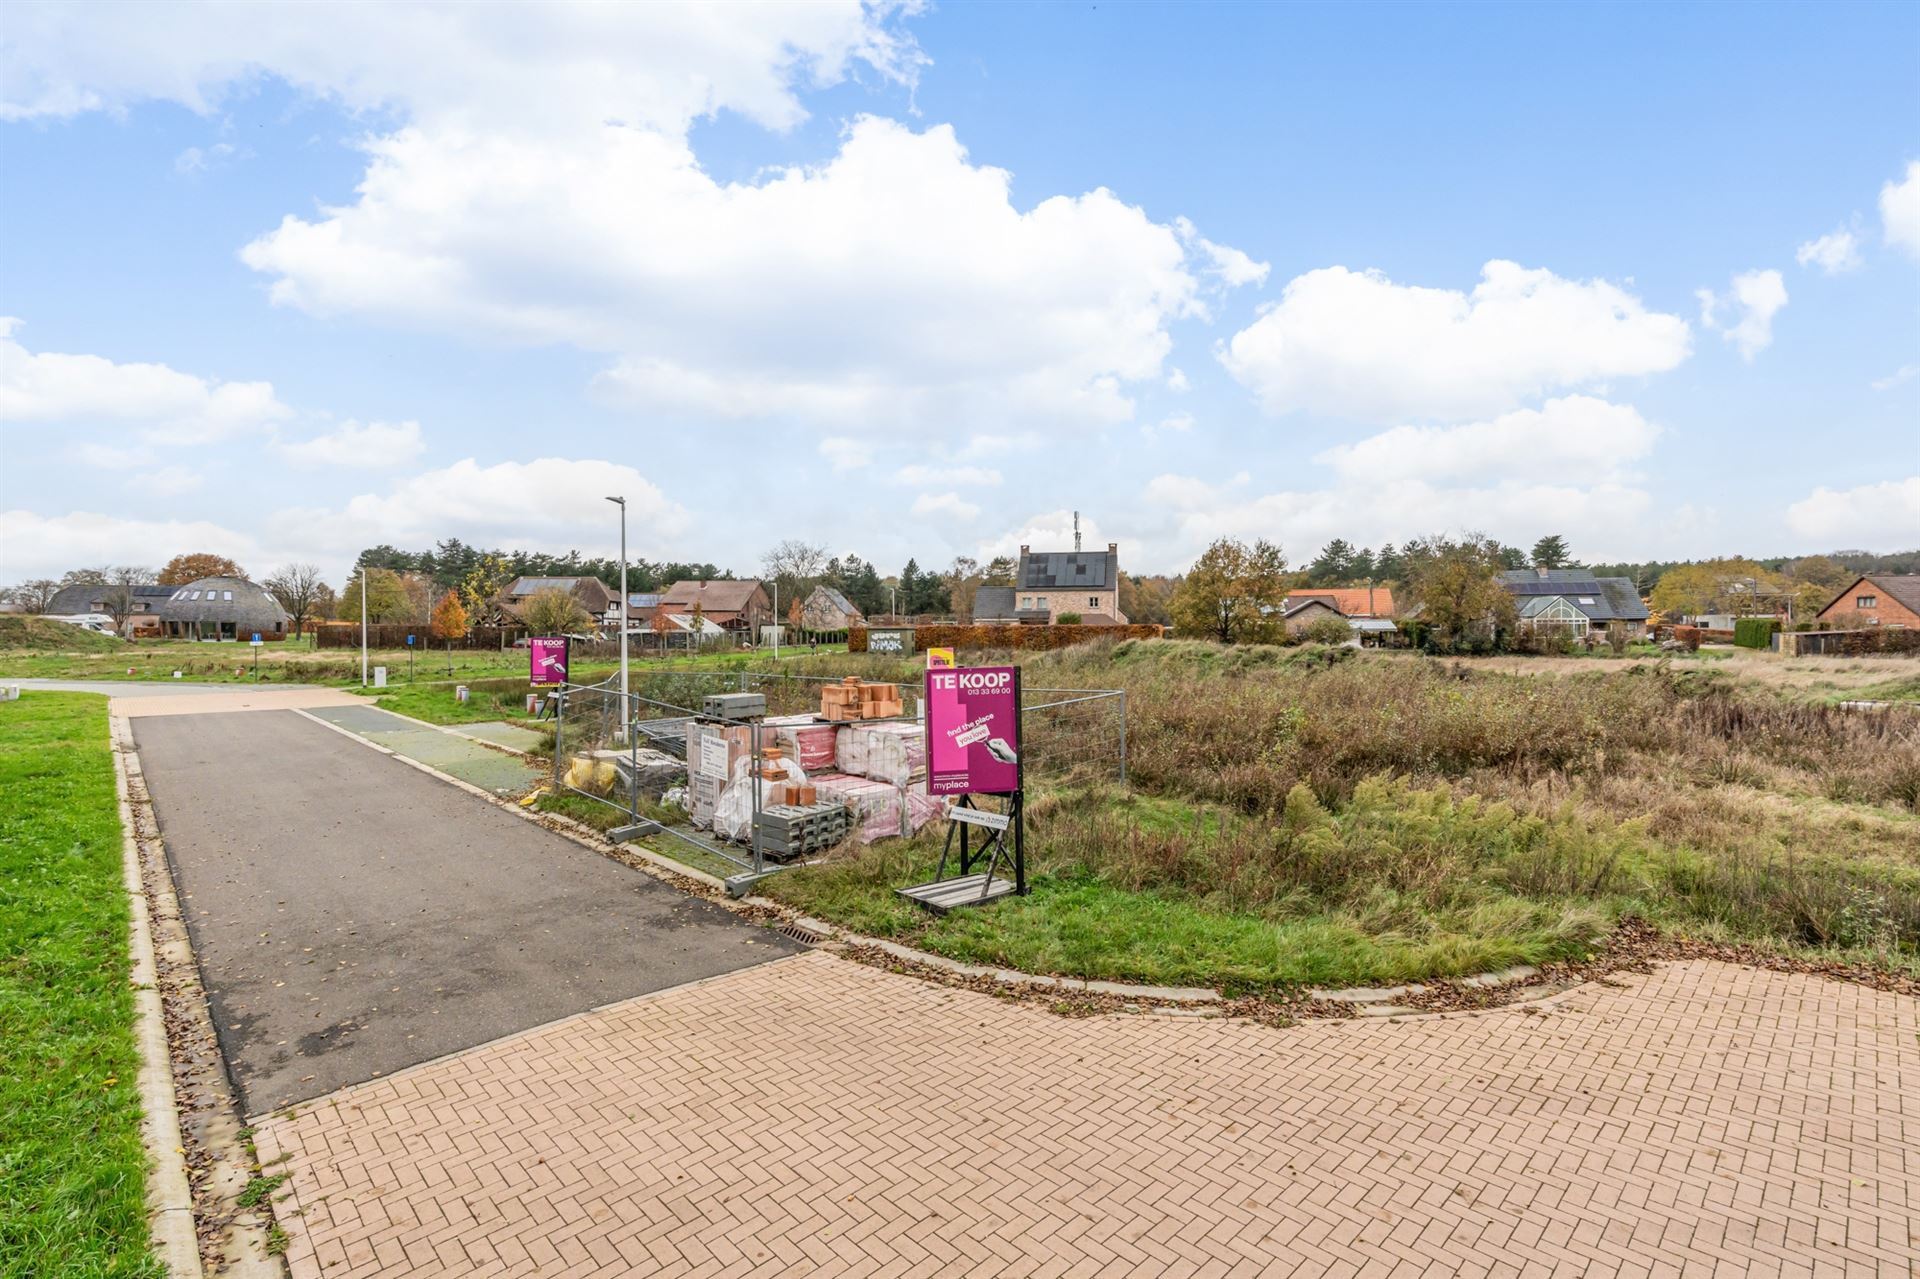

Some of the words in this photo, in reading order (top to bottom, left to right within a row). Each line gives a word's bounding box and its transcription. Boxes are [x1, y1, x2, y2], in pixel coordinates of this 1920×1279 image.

[932, 674, 956, 690] TE
[960, 672, 1011, 688] KOOP
[946, 726, 962, 737] find
[962, 722, 975, 731] the
[975, 713, 994, 726] place
[960, 734, 972, 744] you
[934, 780, 969, 790] myplace
